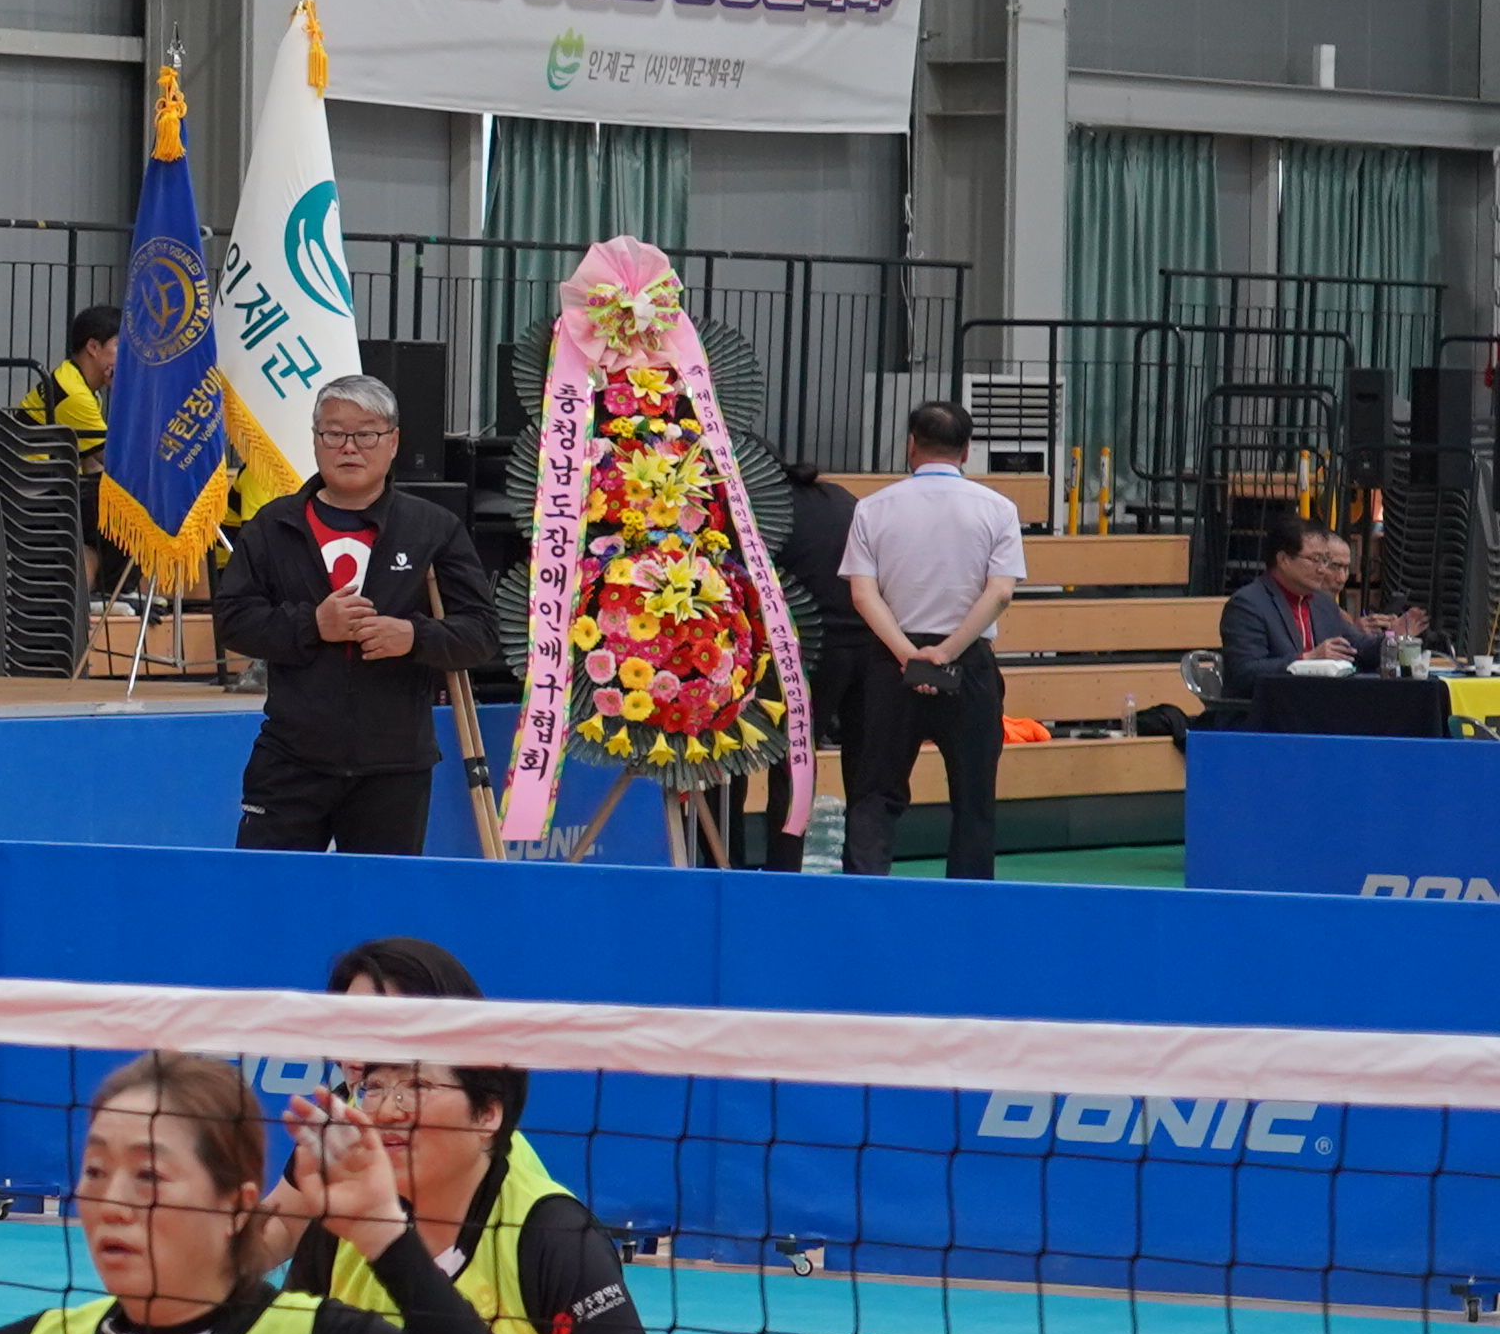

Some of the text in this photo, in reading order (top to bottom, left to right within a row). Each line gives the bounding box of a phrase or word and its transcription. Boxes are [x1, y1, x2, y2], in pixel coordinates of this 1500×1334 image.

[588, 49, 637, 84] 인제군
[643, 55, 745, 89] (사)인제군체육회
[219, 241, 323, 401] 인제군
[519, 383, 584, 782] 충청남도장애인배구협회
[770, 624, 809, 767] 전국장애인배구대회
[977, 1091, 1318, 1155] DONIC
